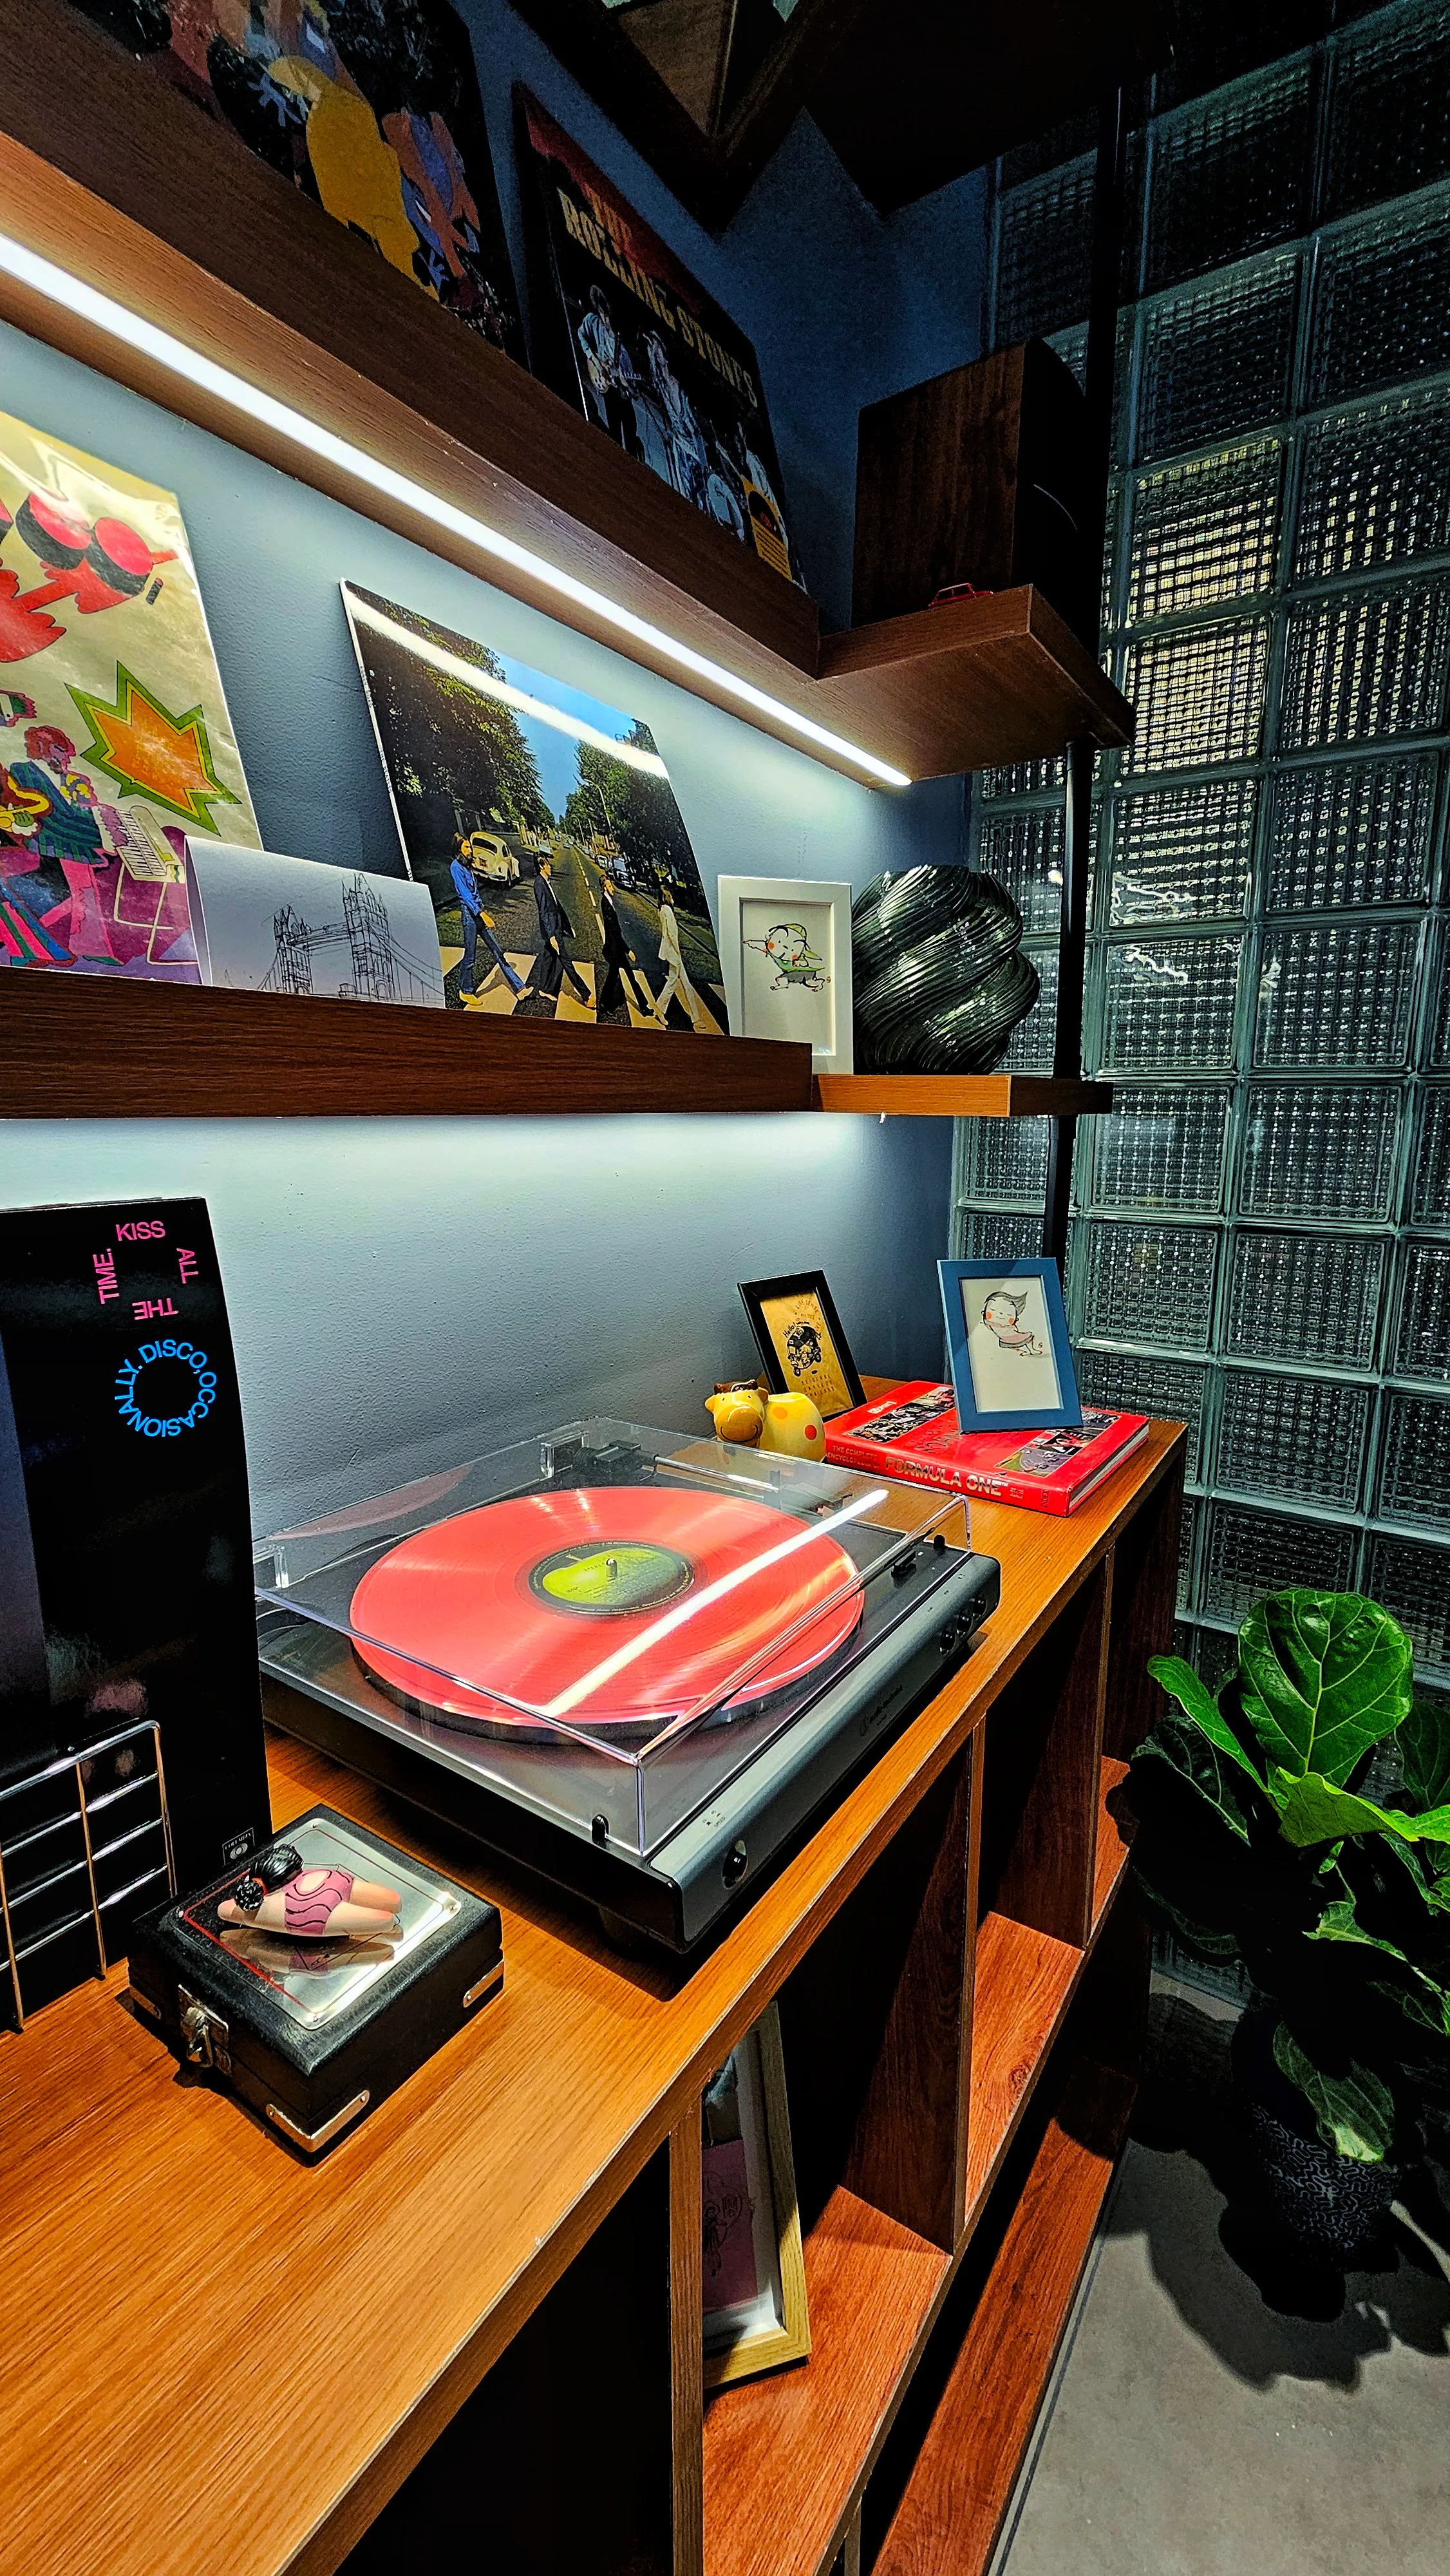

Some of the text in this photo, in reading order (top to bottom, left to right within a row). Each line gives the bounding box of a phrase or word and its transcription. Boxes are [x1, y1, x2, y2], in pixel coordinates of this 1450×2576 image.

[557, 186, 677, 332] ROLLING
[676, 305, 758, 408] STONES
[93, 1220, 200, 1320] KISS ALL THE TIME.
[782, 1321, 796, 1339] Hello!
[115, 1339, 217, 1437] DISCO, OCCASIONALLY.
[885, 1456, 963, 1488] FORMULA
